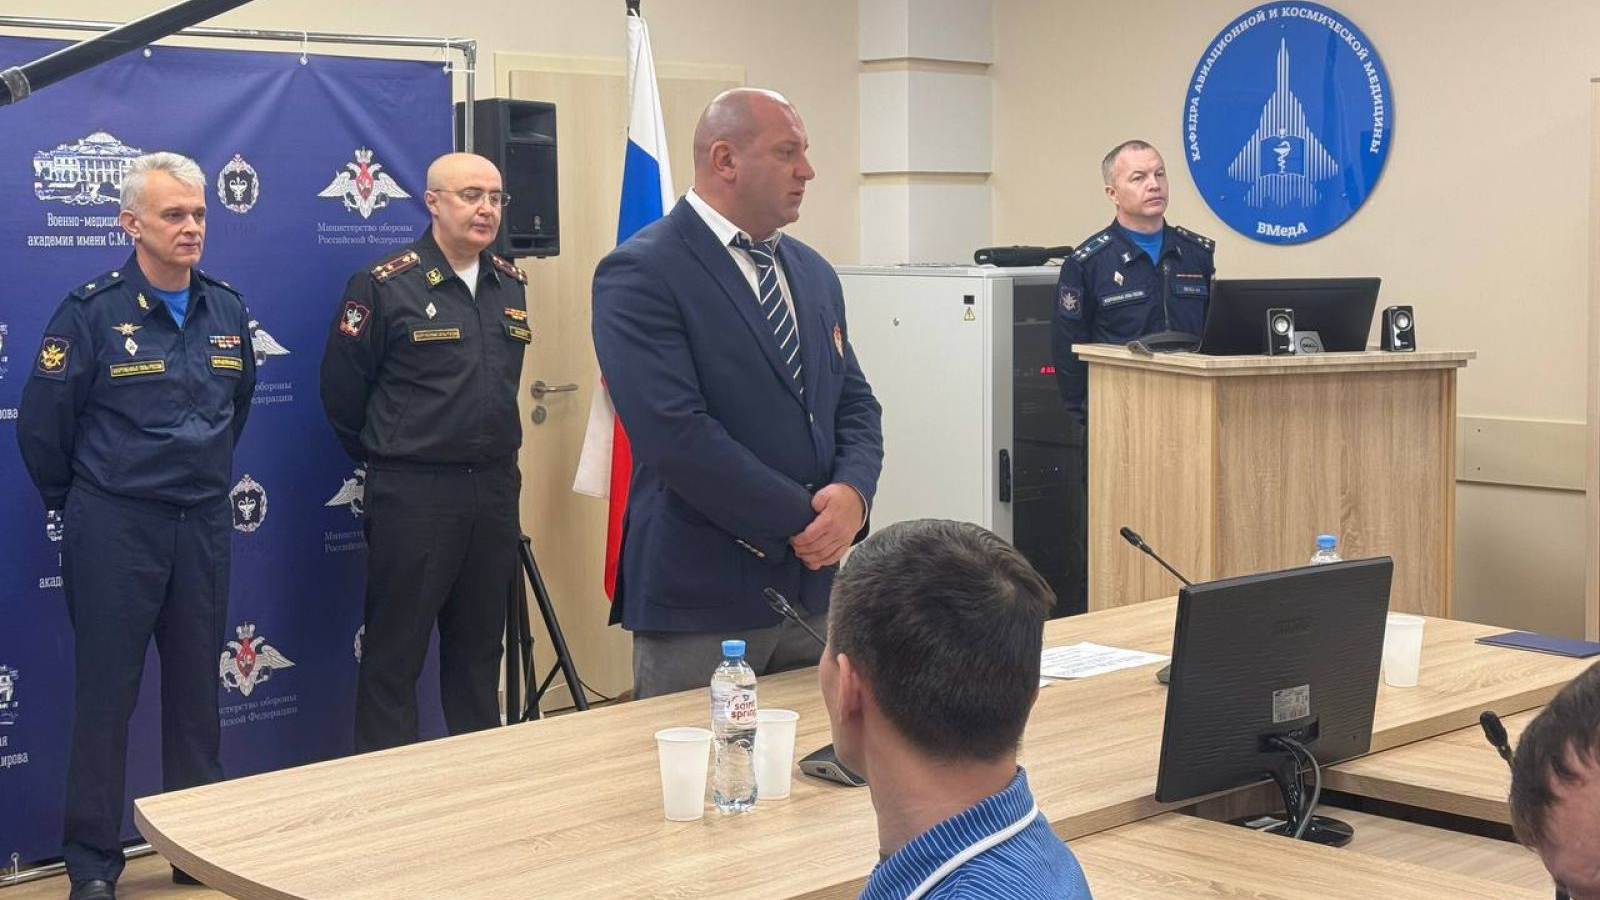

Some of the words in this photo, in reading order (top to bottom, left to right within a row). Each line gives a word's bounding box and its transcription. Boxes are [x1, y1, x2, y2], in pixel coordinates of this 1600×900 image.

[1189, 97, 1200, 162] КАФЕДРА
[1195, 10, 1266, 94] АВИАЦИОННОЙ
[1268, 8, 1279, 19] И
[1281, 7, 1369, 60] КОСМИЧЕСКОЙ
[1363, 61, 1384, 154] МЕДИЦИНЫ
[47, 212, 121, 229] Военно-медици
[1256, 221, 1308, 238] ВМедА
[27, 235, 75, 247] академия
[76, 235, 107, 246] имени
